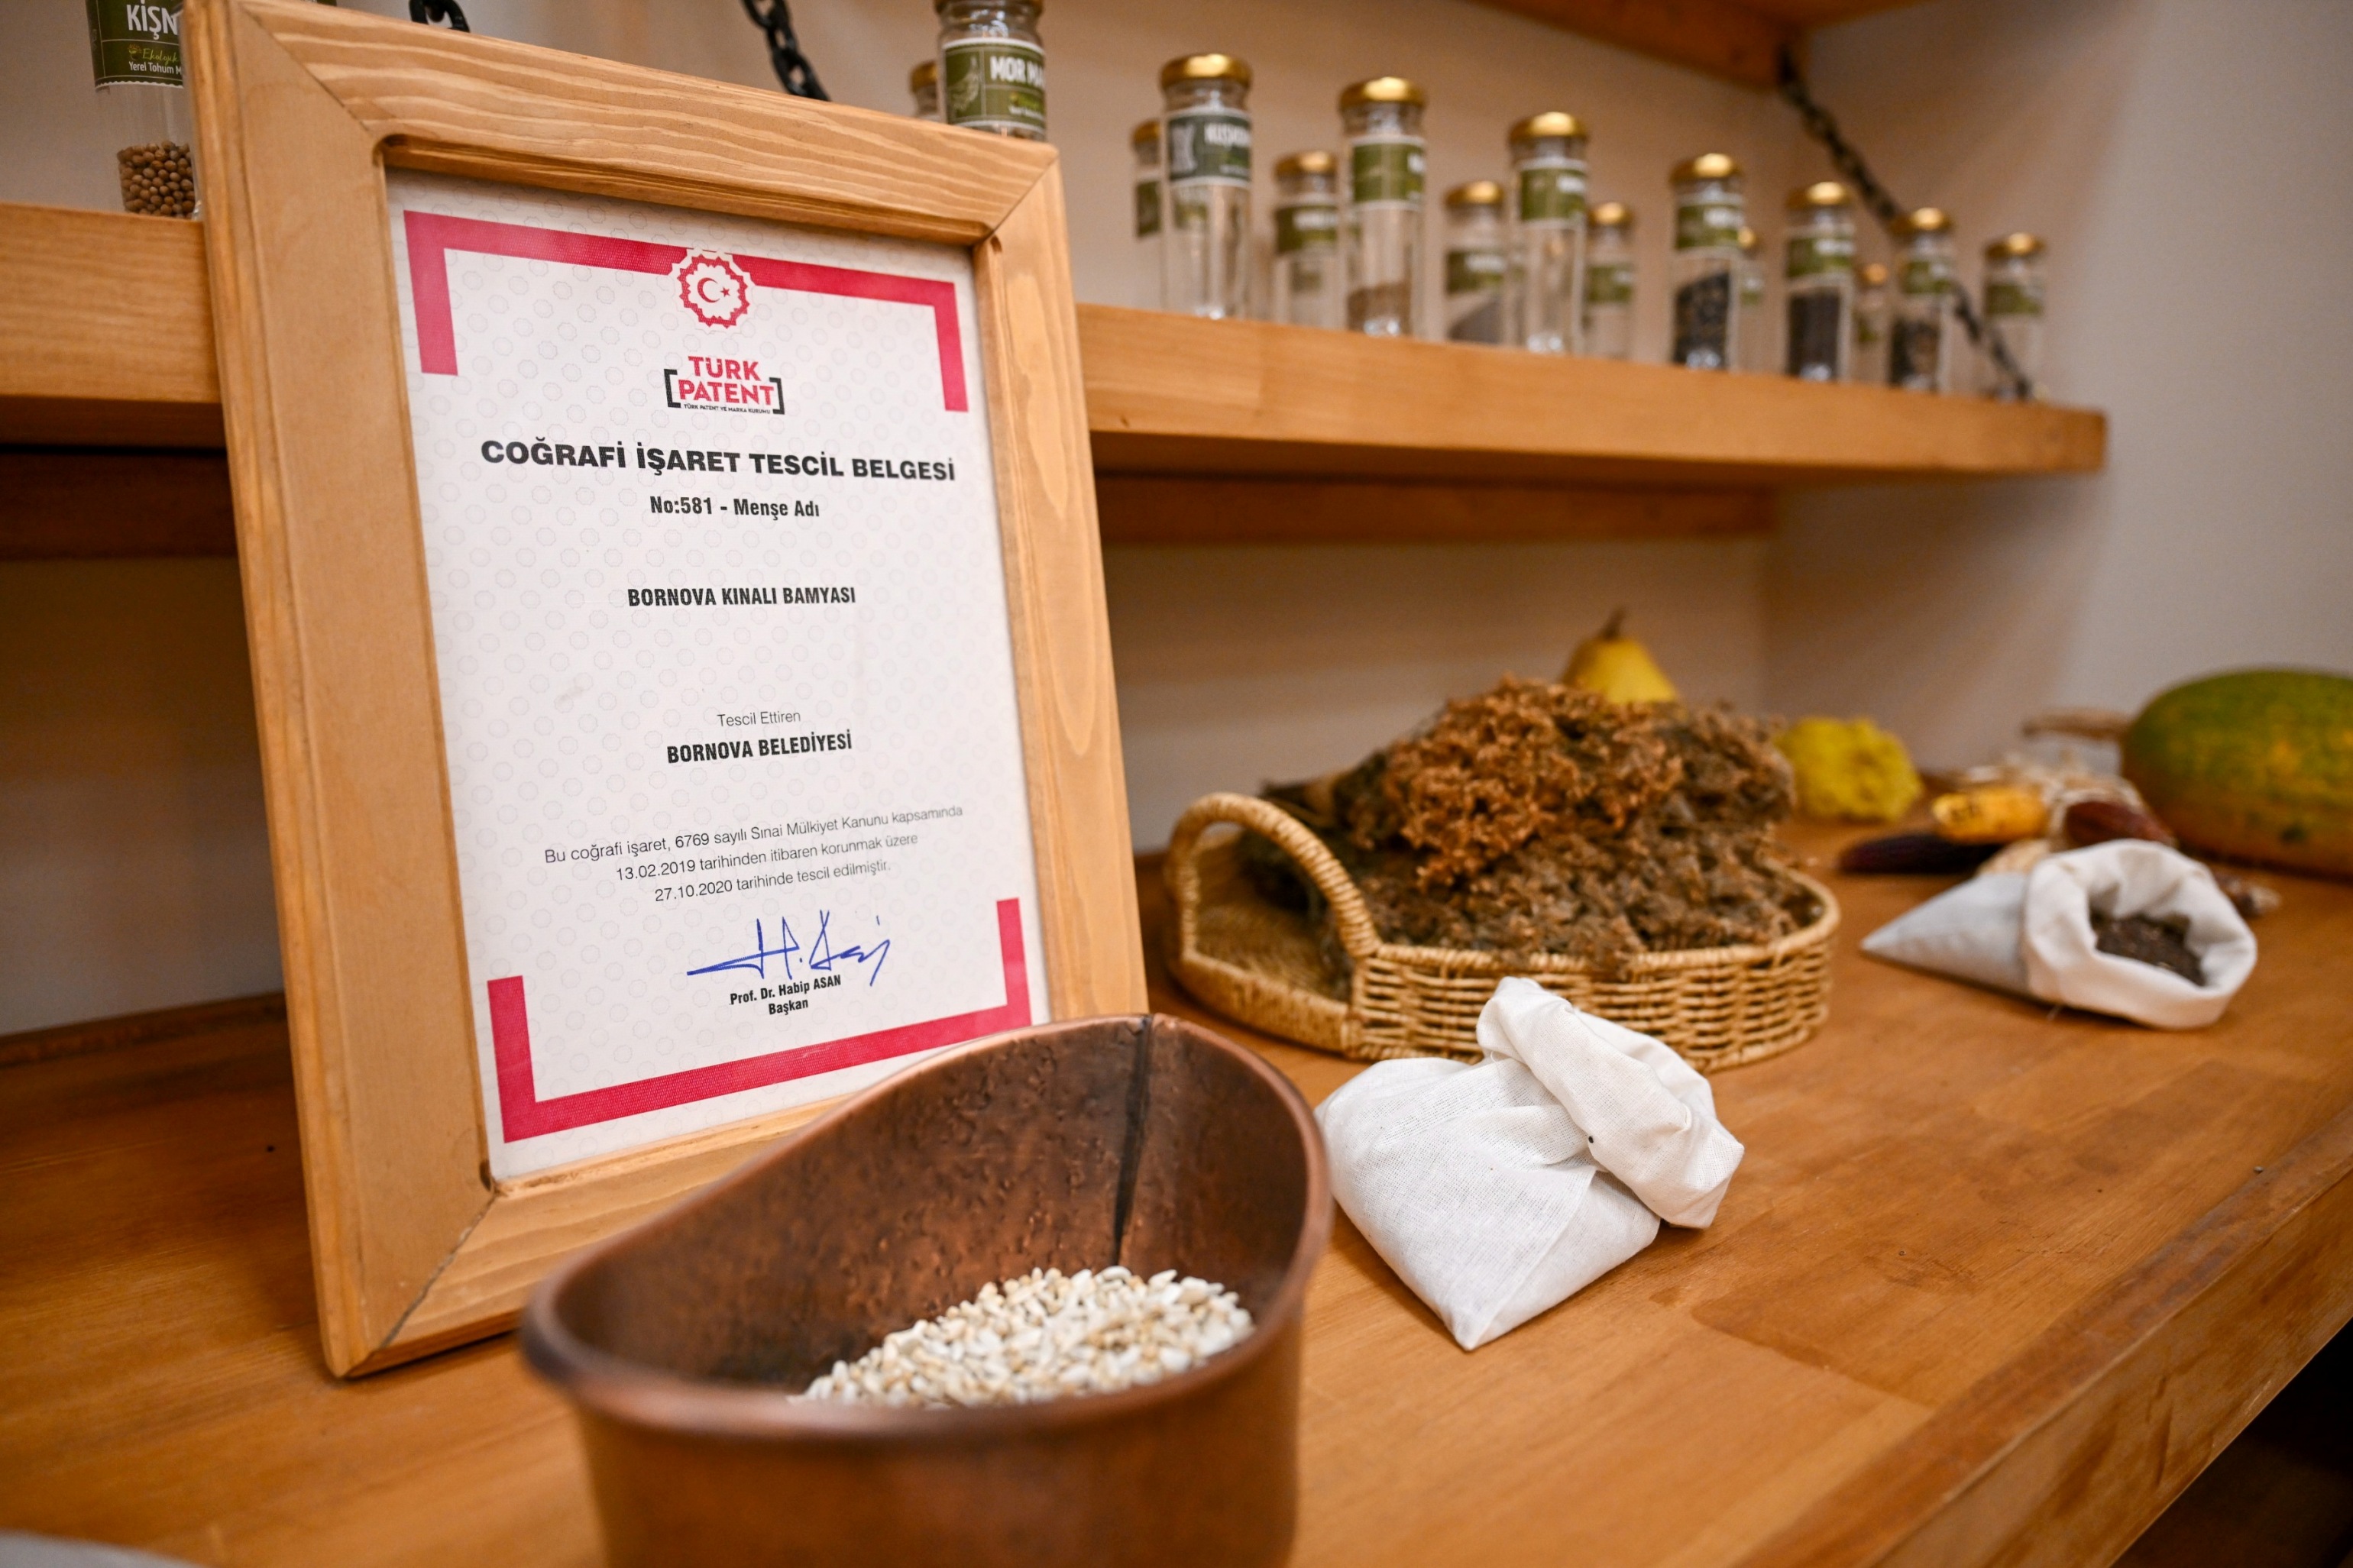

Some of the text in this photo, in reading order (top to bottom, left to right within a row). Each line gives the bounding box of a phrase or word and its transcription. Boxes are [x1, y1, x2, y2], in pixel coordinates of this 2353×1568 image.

[128, 61, 147, 72] Yerel
[148, 62, 174, 74] Tohum
[688, 355, 762, 382] TÜRK
[678, 379, 775, 406] PATENT
[481, 436, 956, 481] COĞRAFİ İŞARET TESCİL BELGESİ
[649, 496, 712, 515] No:581
[733, 498, 788, 521] Menşe
[794, 500, 820, 517] Adı
[627, 587, 856, 606] BORNOVA KINALI BAMYASI
[717, 710, 801, 727] Tescil Ettiren
[667, 729, 853, 764] BORNOVA BELEDİYESİ
[545, 805, 964, 864] Bu coğrafi işaret, 6769 sayılı Sınai Mülkiyet Kanunu kapsamında
[617, 833, 919, 881] 13.02.2019 tarihinden itibaren korunmak üzere
[655, 859, 892, 902] 27.10.2020 tarihinde tescil edilmiştir.
[730, 975, 842, 1006] Prof. Dr. Habip ASAN
[768, 998, 809, 1016] Başkan
